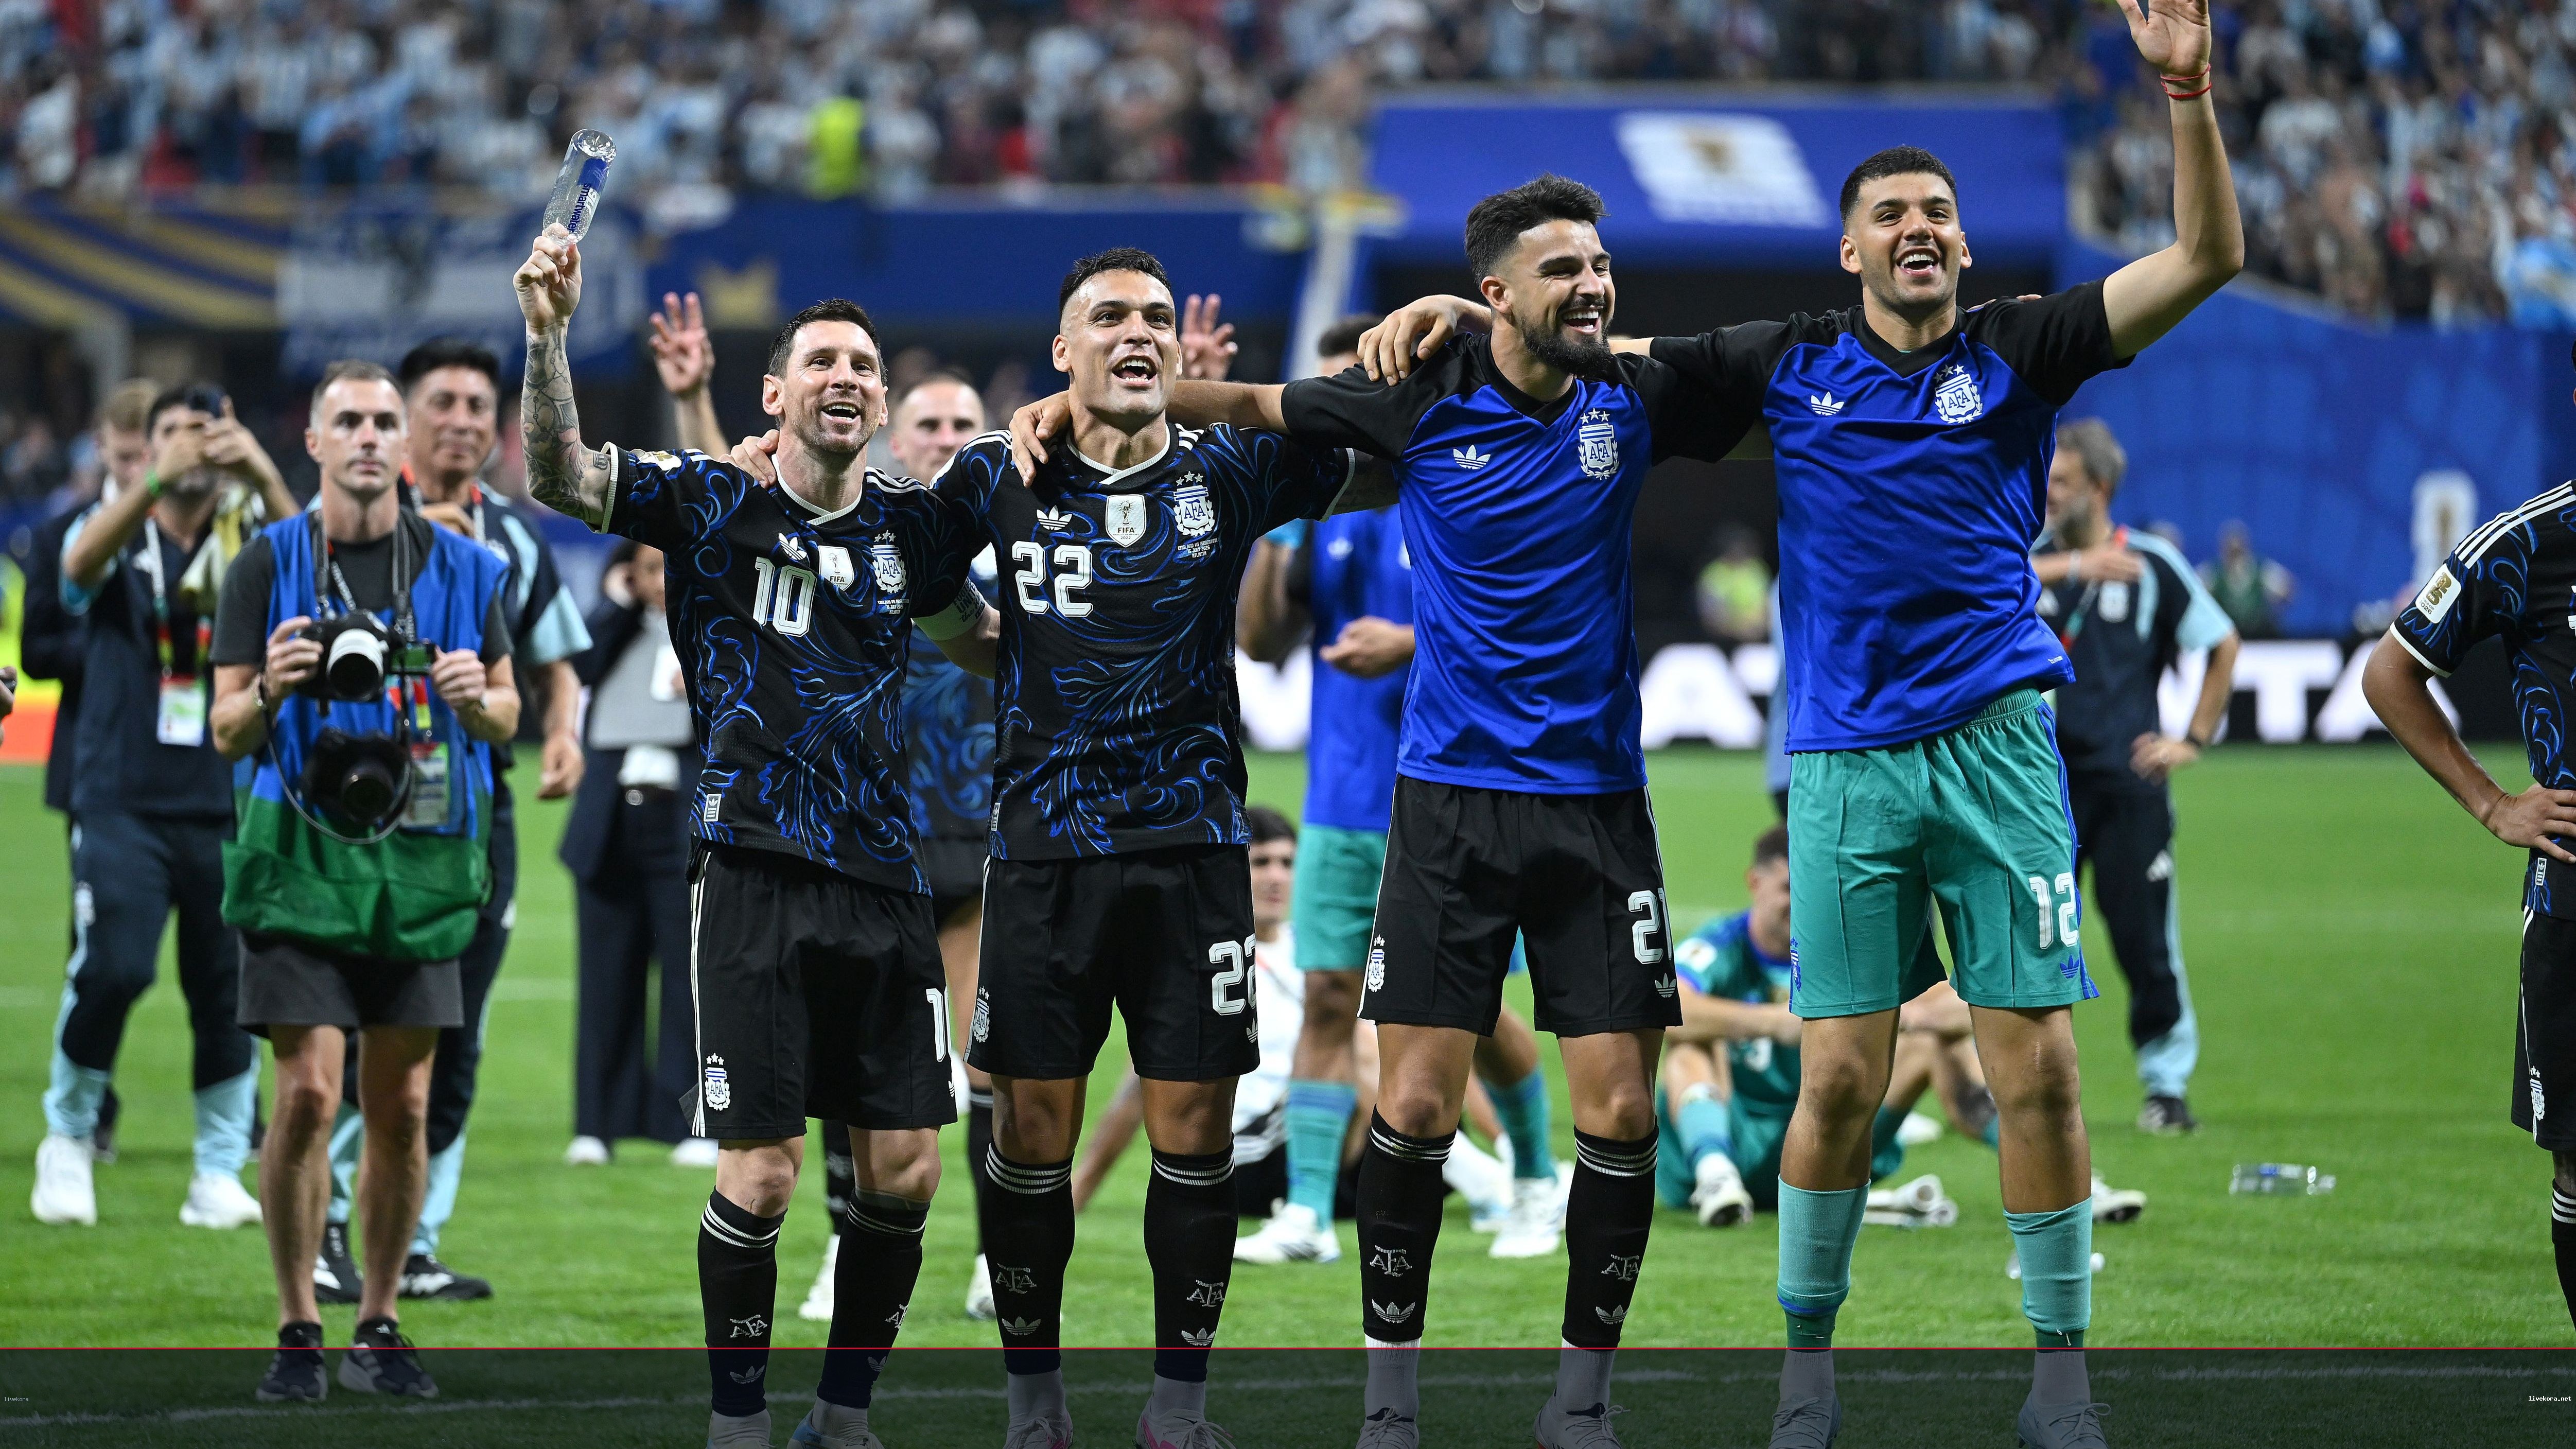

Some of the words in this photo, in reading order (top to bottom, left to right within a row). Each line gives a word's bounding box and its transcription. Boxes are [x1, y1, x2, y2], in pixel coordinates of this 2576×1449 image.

[567, 182, 592, 233] smartwater
[1947, 388, 1970, 408] AFA
[1589, 440, 1610, 462] AFA
[1184, 499, 1206, 521] AFA
[882, 557, 900, 578] AFA
[1012, 540, 1094, 617] 22
[752, 556, 817, 637] 10
[2028, 871, 2079, 949] 12
[1628, 887, 1672, 965] 21
[926, 988, 952, 1062] 1
[710, 1079, 724, 1098] AFA
[1369, 1245, 1412, 1277] AFA
[1601, 1254, 1639, 1281] AFA
[995, 1263, 1037, 1294] AFA
[1186, 1279, 1224, 1307] AFA
[729, 1314, 768, 1338] AFA
